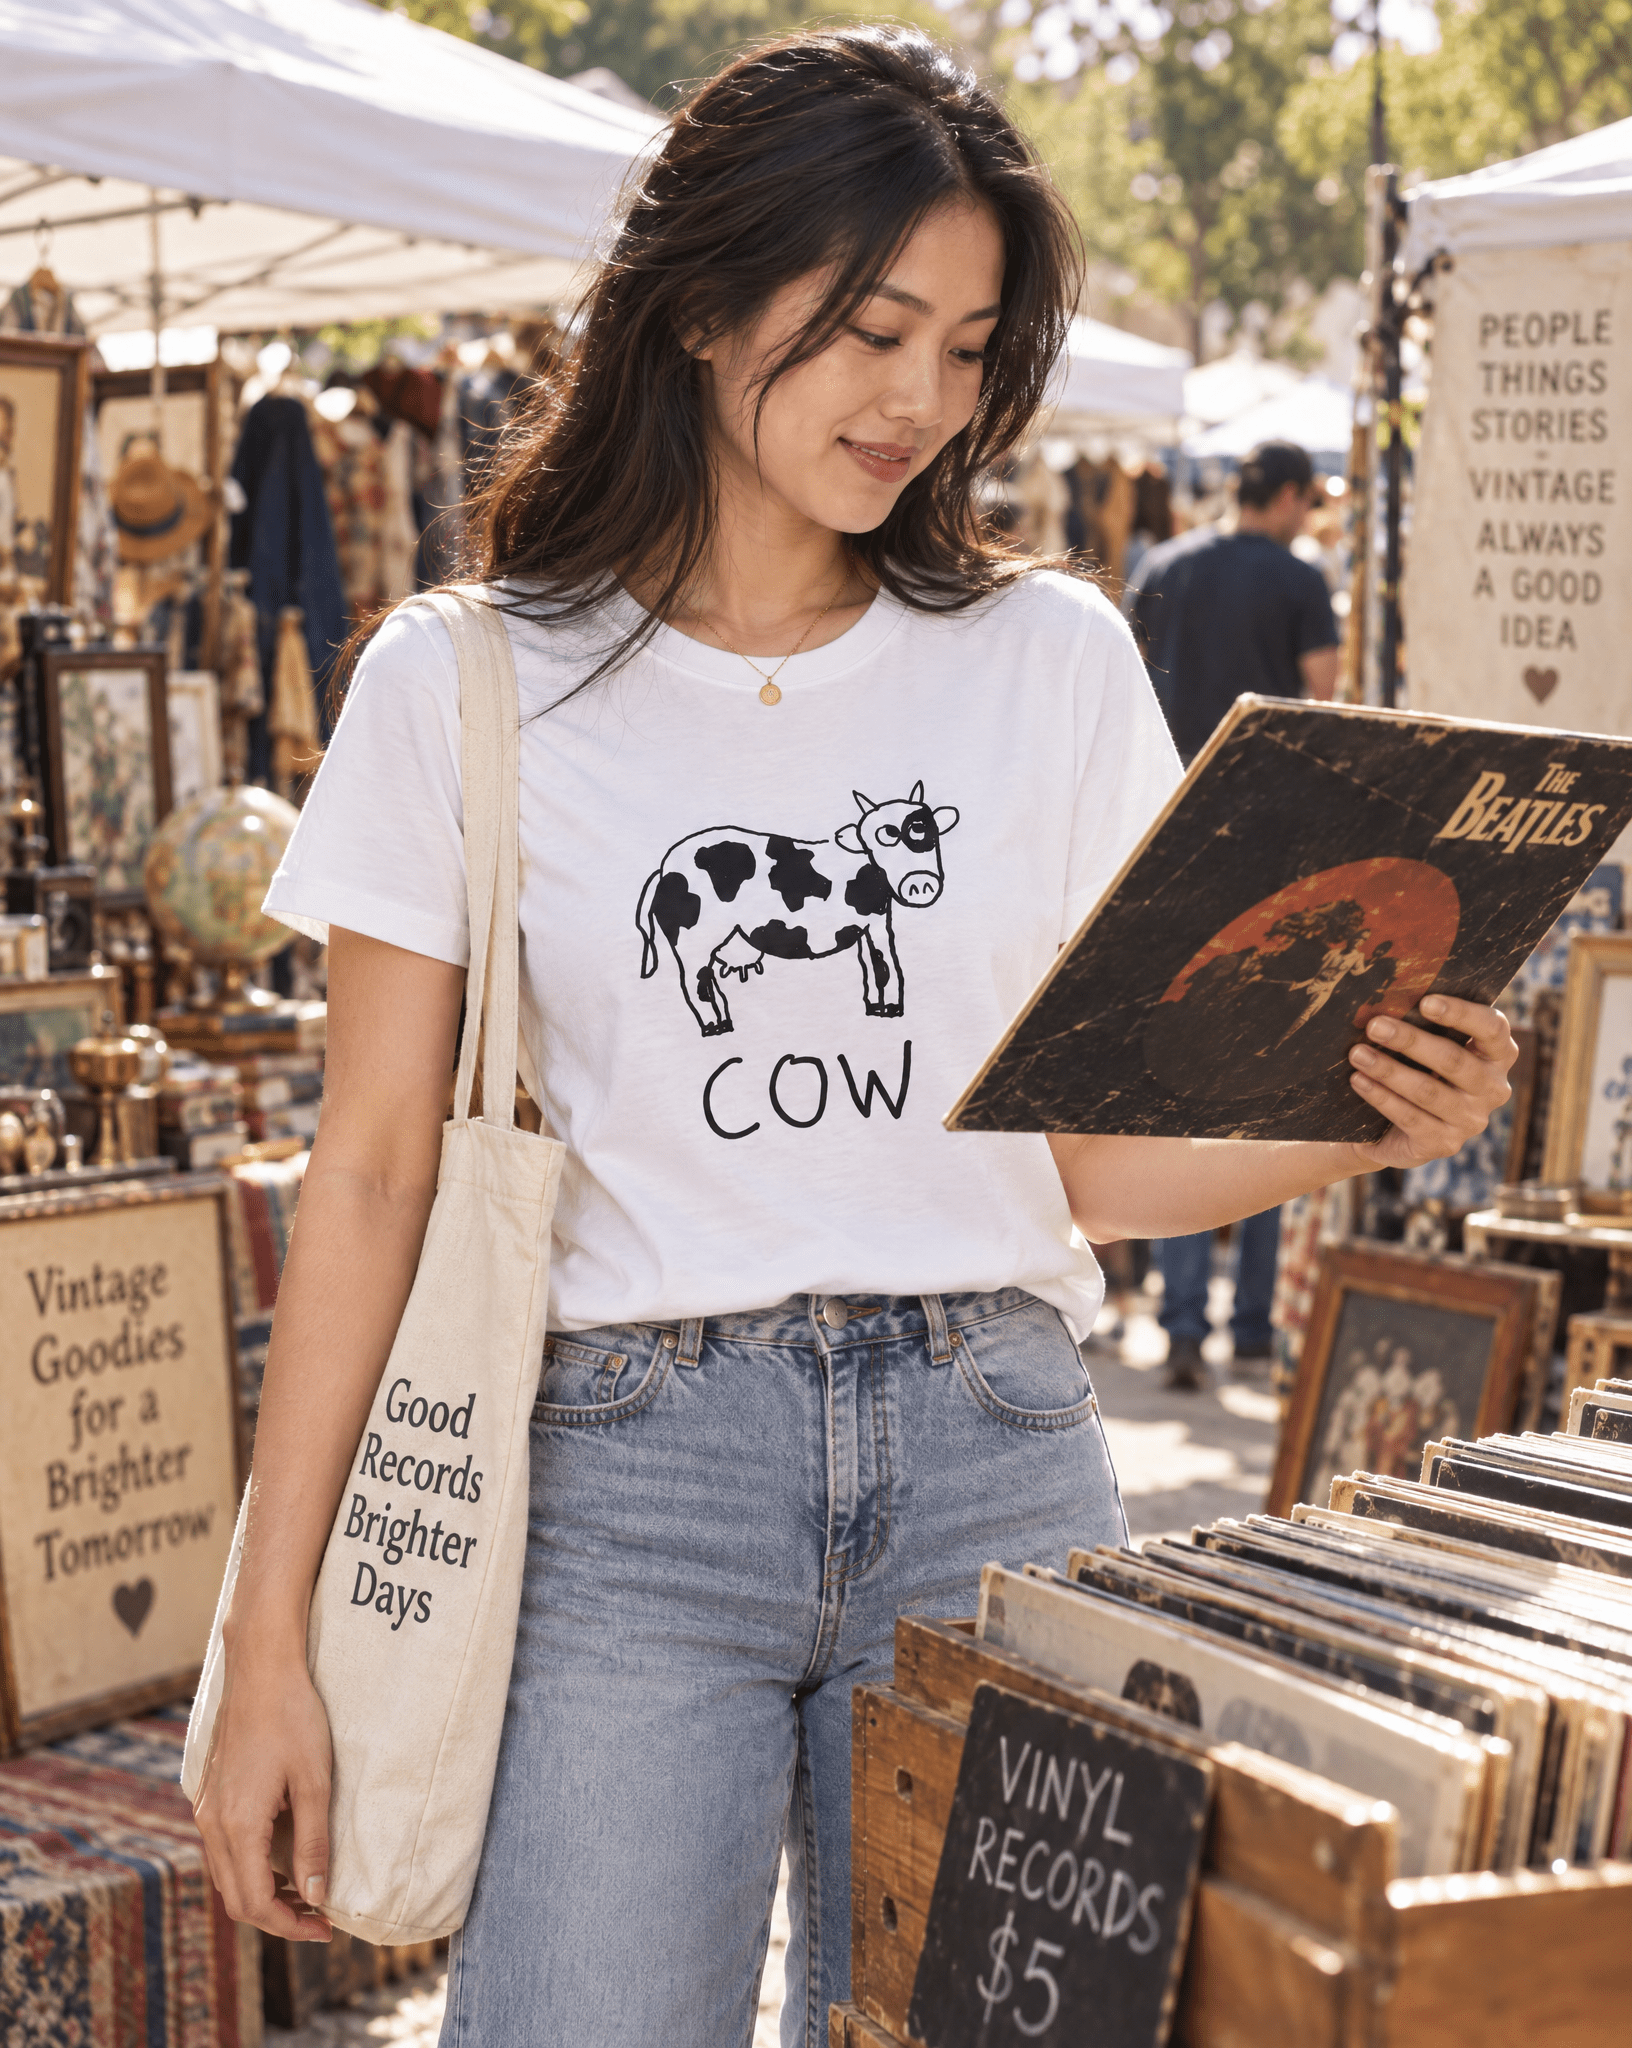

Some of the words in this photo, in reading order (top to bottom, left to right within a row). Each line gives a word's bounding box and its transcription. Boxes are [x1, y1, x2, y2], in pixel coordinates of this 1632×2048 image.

[1479, 309, 1612, 348] PEOPLE
[1479, 361, 1608, 396] THINGS
[1471, 408, 1608, 443] STORIES
[1468, 467, 1616, 504] VINTAGE
[1475, 519, 1606, 557] ALWAYS
[1473, 566, 1496, 599] A
[1512, 567, 1603, 606] GOOD
[1500, 614, 1577, 652] IDEA
[1534, 762, 1582, 794] THE
[1434, 770, 1608, 854] BEATLES
[703, 1040, 912, 1139] COW
[26, 1261, 169, 1317] Vintage
[31, 1315, 185, 1385] Goodies
[69, 1388, 125, 1453] for
[139, 1388, 160, 1424] a
[385, 1378, 476, 1439] Good
[46, 1442, 193, 1513] Brighter
[359, 1432, 483, 1503] Records
[34, 1506, 215, 1582] Tomorrow
[343, 1493, 477, 1569] Brighter
[350, 1561, 432, 1631] Days
[1000, 1736, 1132, 1848] VINYL
[968, 1816, 1165, 1955] RECORDS
[976, 1909, 1065, 2037] $5
